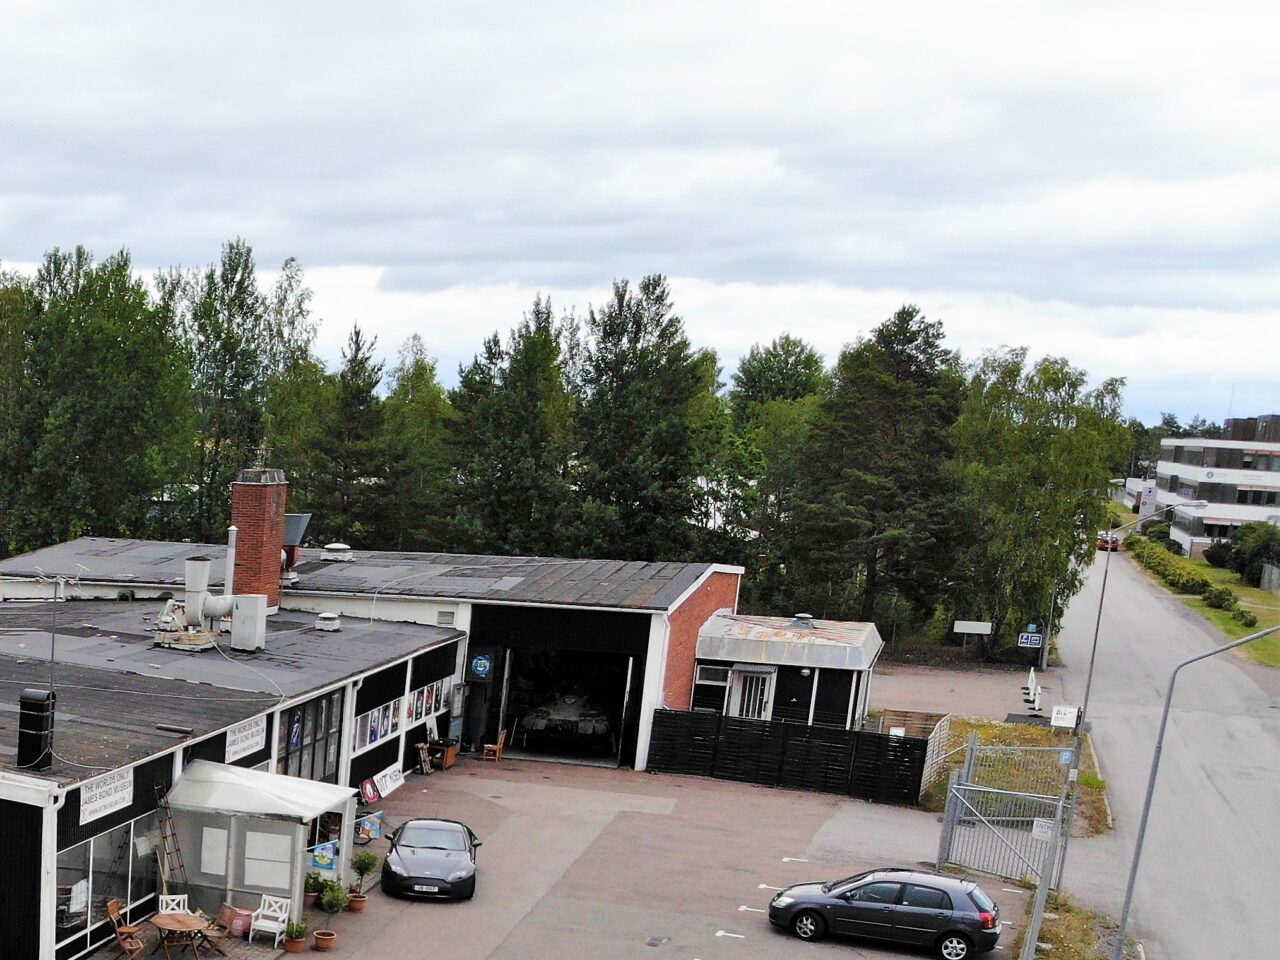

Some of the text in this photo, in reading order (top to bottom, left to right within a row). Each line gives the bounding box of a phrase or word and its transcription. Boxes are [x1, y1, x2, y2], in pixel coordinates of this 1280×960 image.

[84, 783, 94, 794] THE
[95, 775, 116, 789] WORLDS
[99, 788, 113, 800] BOND
